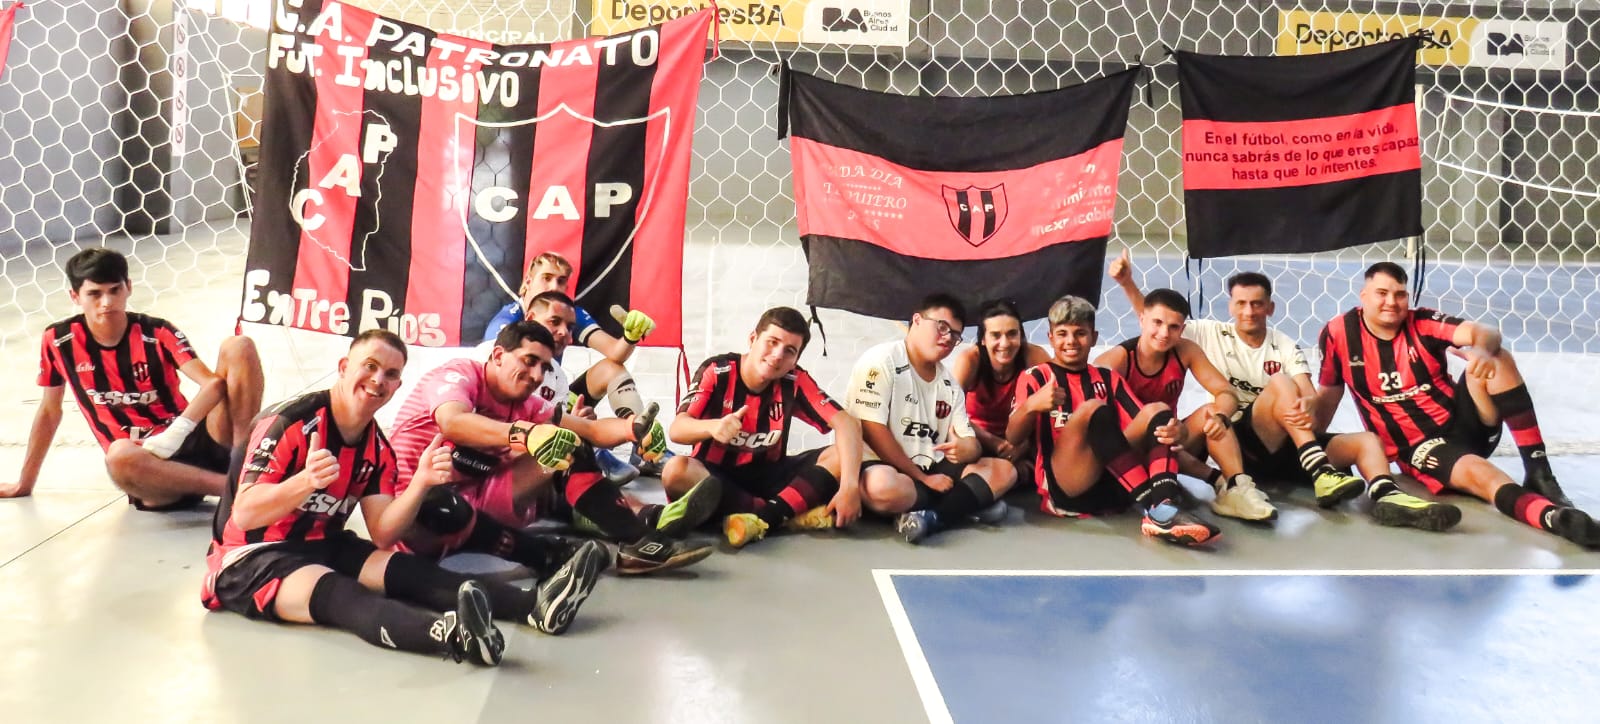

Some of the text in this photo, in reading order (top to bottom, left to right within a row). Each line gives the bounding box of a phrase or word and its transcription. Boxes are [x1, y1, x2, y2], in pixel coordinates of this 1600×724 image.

[612, 0, 786, 26] DeporesBA
[365, 18, 658, 67] PATRONATO
[1292, 134, 1332, 144] como
[1185, 151, 1229, 162] nunca
[1232, 150, 1280, 163] sabrás
[1284, 150, 1302, 162] de
[1306, 149, 1319, 161] lo
[1323, 149, 1344, 161] que
[1347, 144, 1379, 156] eres
[1232, 167, 1268, 180] hasta
[1274, 167, 1299, 181] que
[1305, 164, 1317, 176] lo
[960, 203, 994, 212] CAP
[1378, 371, 1403, 391] 23
[729, 430, 782, 449] SCO
